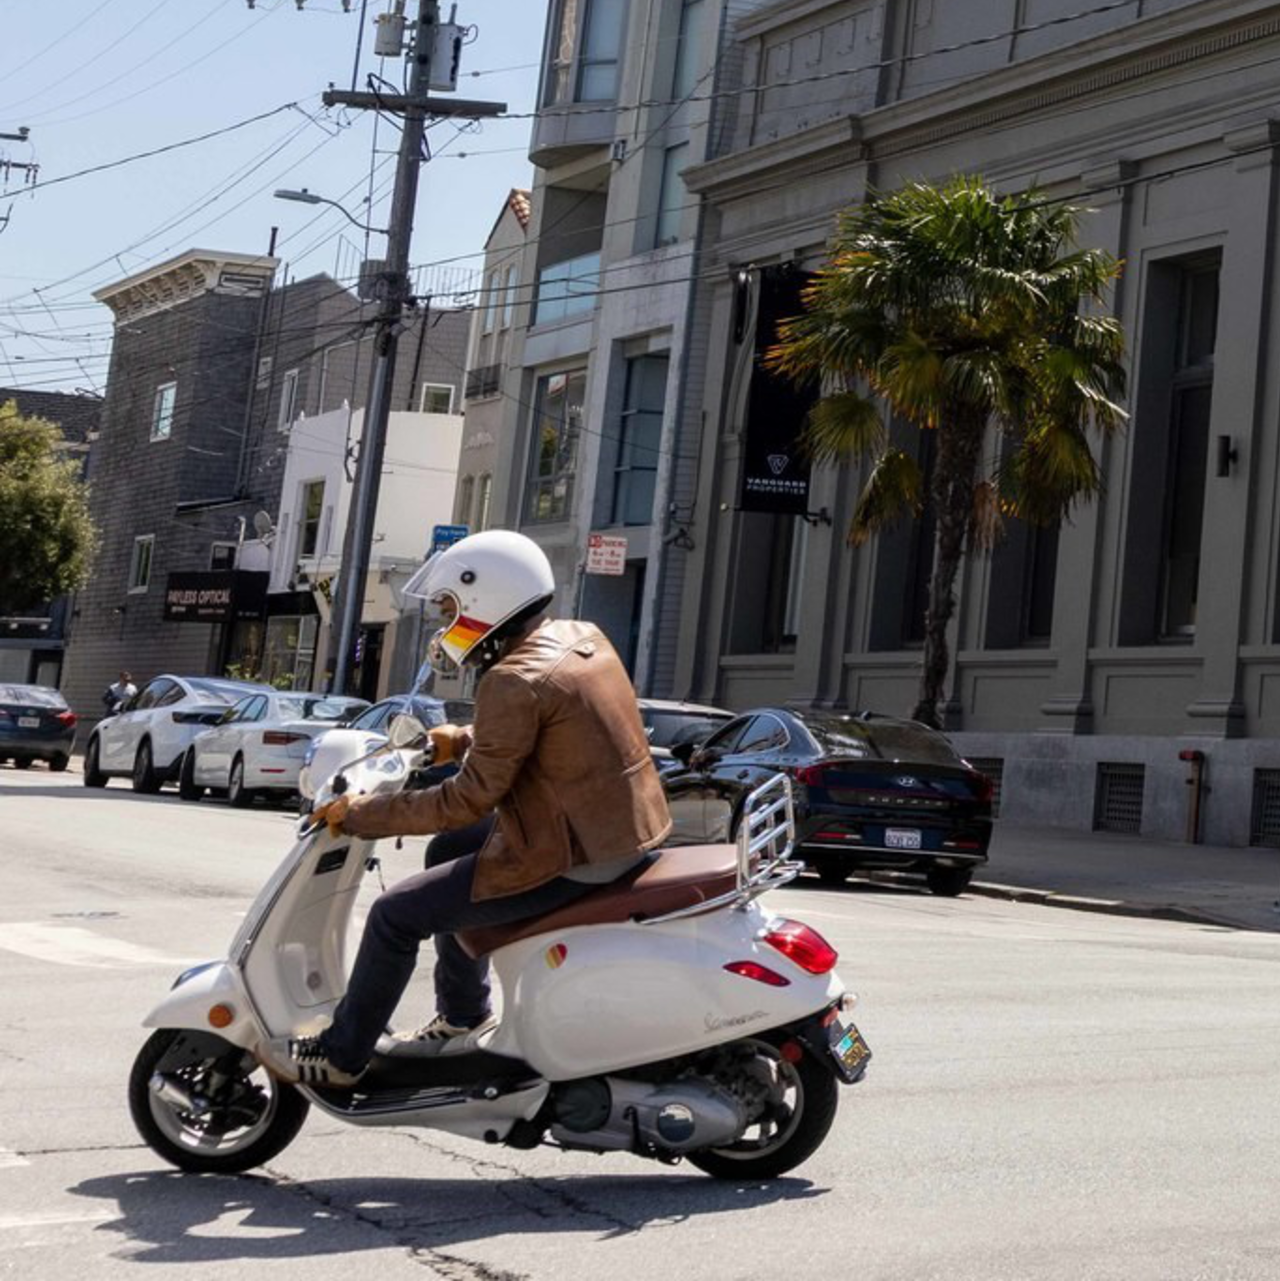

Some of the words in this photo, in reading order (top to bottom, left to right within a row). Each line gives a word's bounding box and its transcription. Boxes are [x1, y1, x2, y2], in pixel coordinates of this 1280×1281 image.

[747, 477, 806, 487] VANGUARD
[747, 485, 804, 494] PROPERTIES
[198, 588, 230, 604] OPTICAL
